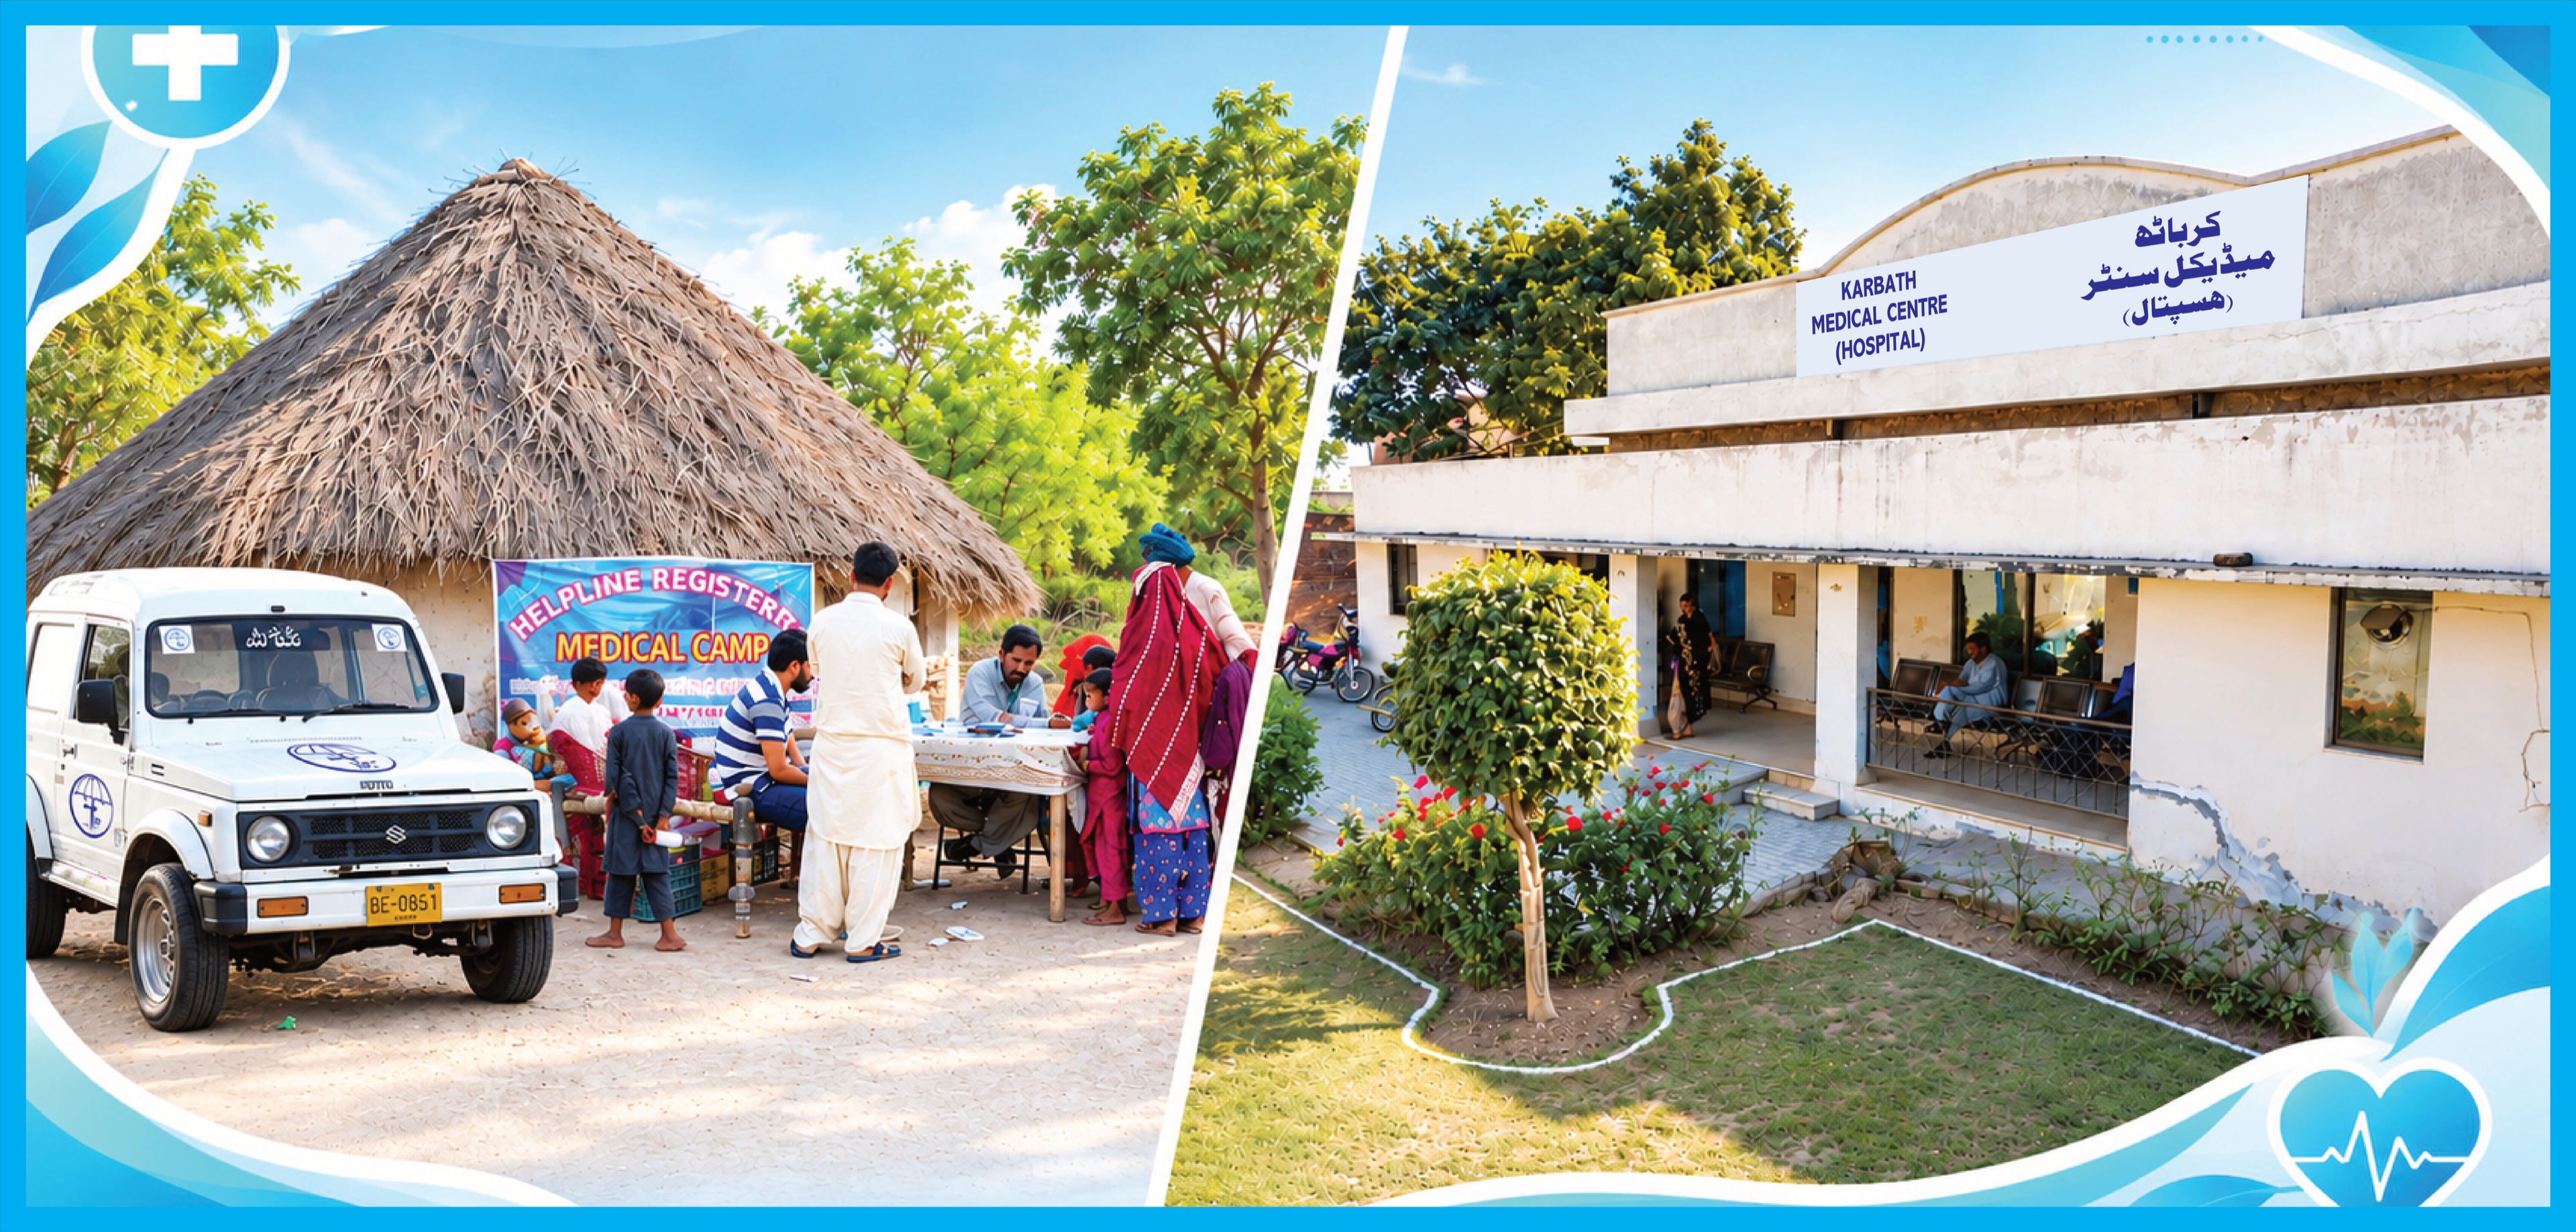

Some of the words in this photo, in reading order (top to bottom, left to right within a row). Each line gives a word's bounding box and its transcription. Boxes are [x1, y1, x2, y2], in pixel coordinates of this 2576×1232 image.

[1841, 270, 1917, 301] KARBATH
[2080, 263, 2159, 301] سنٹر
[1811, 305, 1882, 335] MEDICAL
[1886, 293, 1948, 322] CENTRE
[1835, 327, 1926, 366] (HOSPITAL)
[508, 568, 641, 642] HELPLINE
[556, 631, 686, 663] MEDICAL
[691, 631, 771, 663] CAMP
[370, 894, 437, 915] BE-0851
